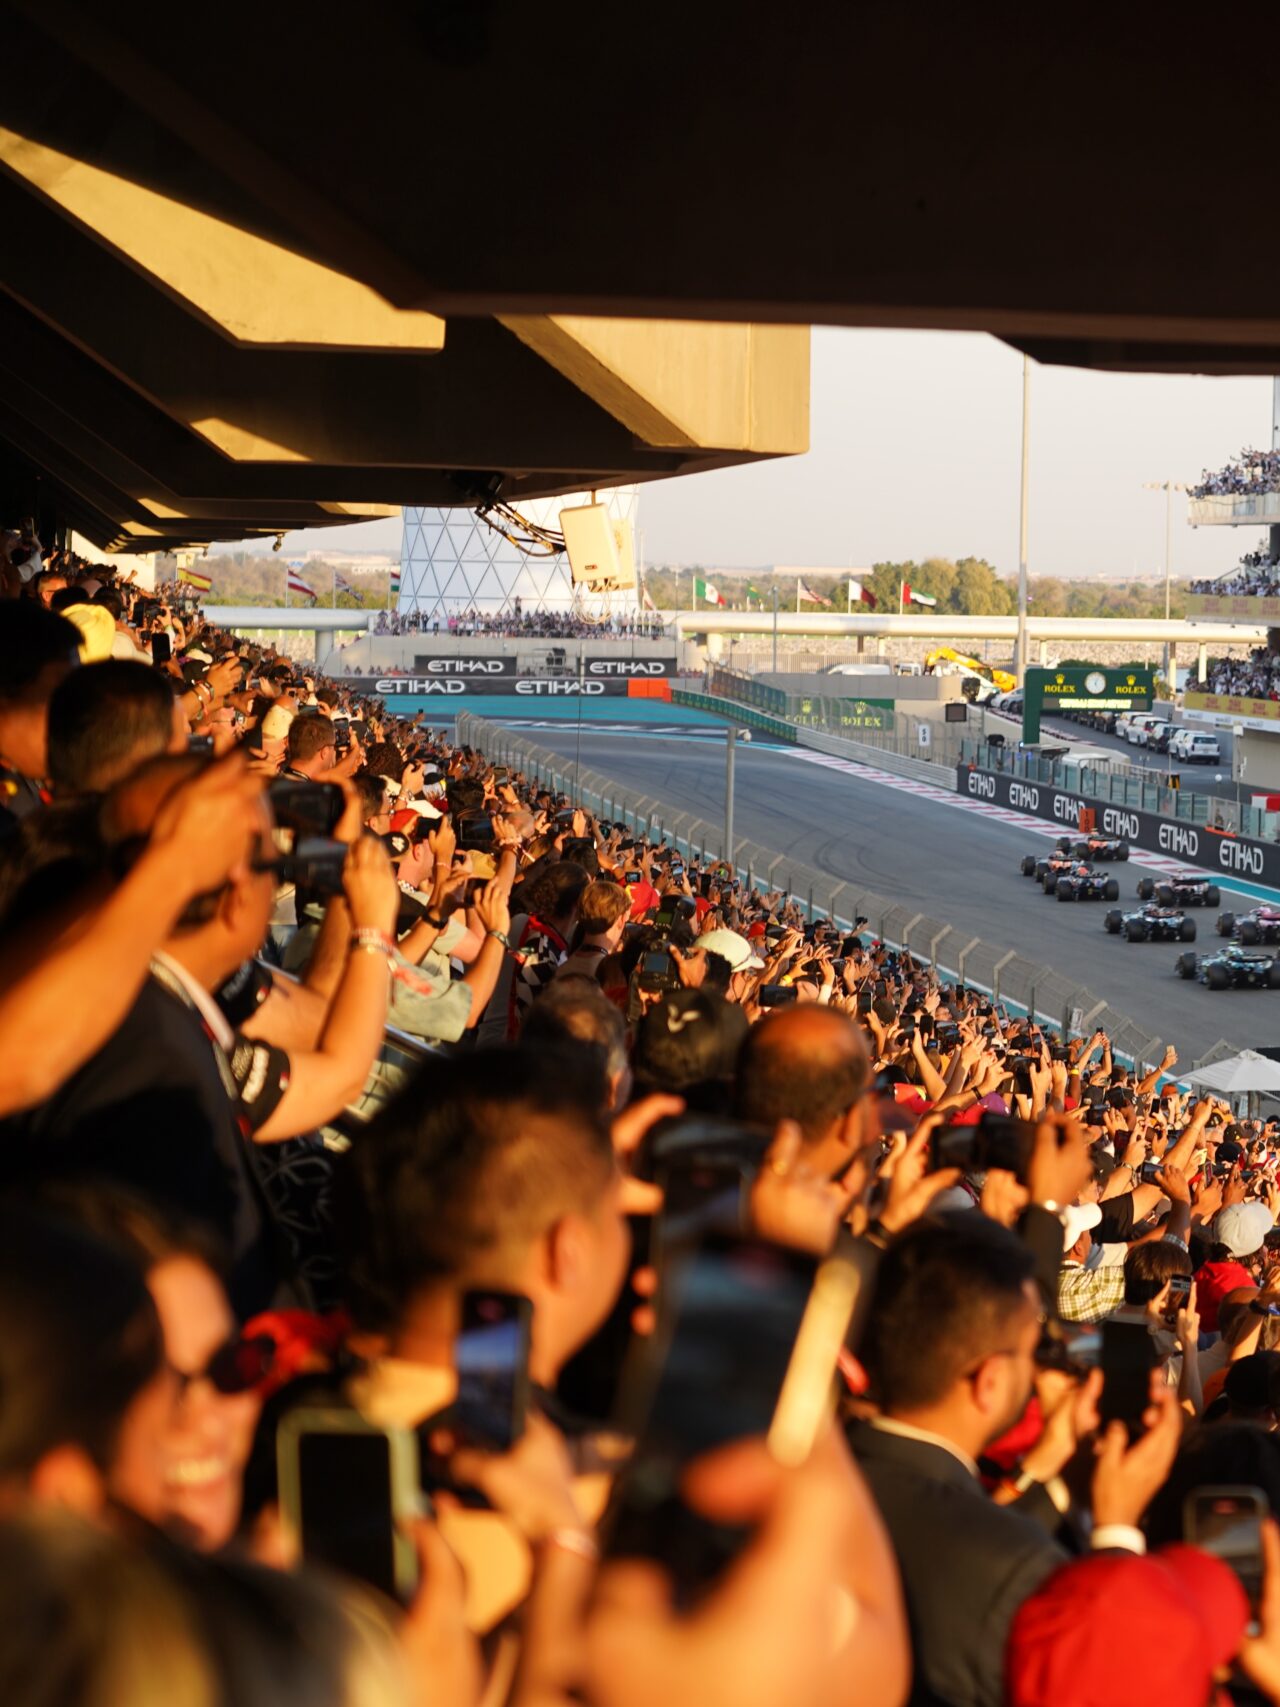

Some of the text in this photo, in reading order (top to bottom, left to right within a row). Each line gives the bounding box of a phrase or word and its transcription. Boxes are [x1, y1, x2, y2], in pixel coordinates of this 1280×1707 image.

[427, 660, 505, 673] ETIHAD
[589, 662, 666, 674] ETIHAD
[375, 679, 466, 695] ETIHAD
[515, 679, 605, 695] ETIHAD
[1044, 685, 1075, 693] ROLEX
[1115, 686, 1146, 694] ROLEX
[968, 772, 996, 798] ETIHAD
[1009, 783, 1040, 810] ETIHAD
[1103, 808, 1139, 839] ETIHAD
[1159, 823, 1198, 856] ETIHAD
[1219, 834, 1264, 875] ETIHAD
